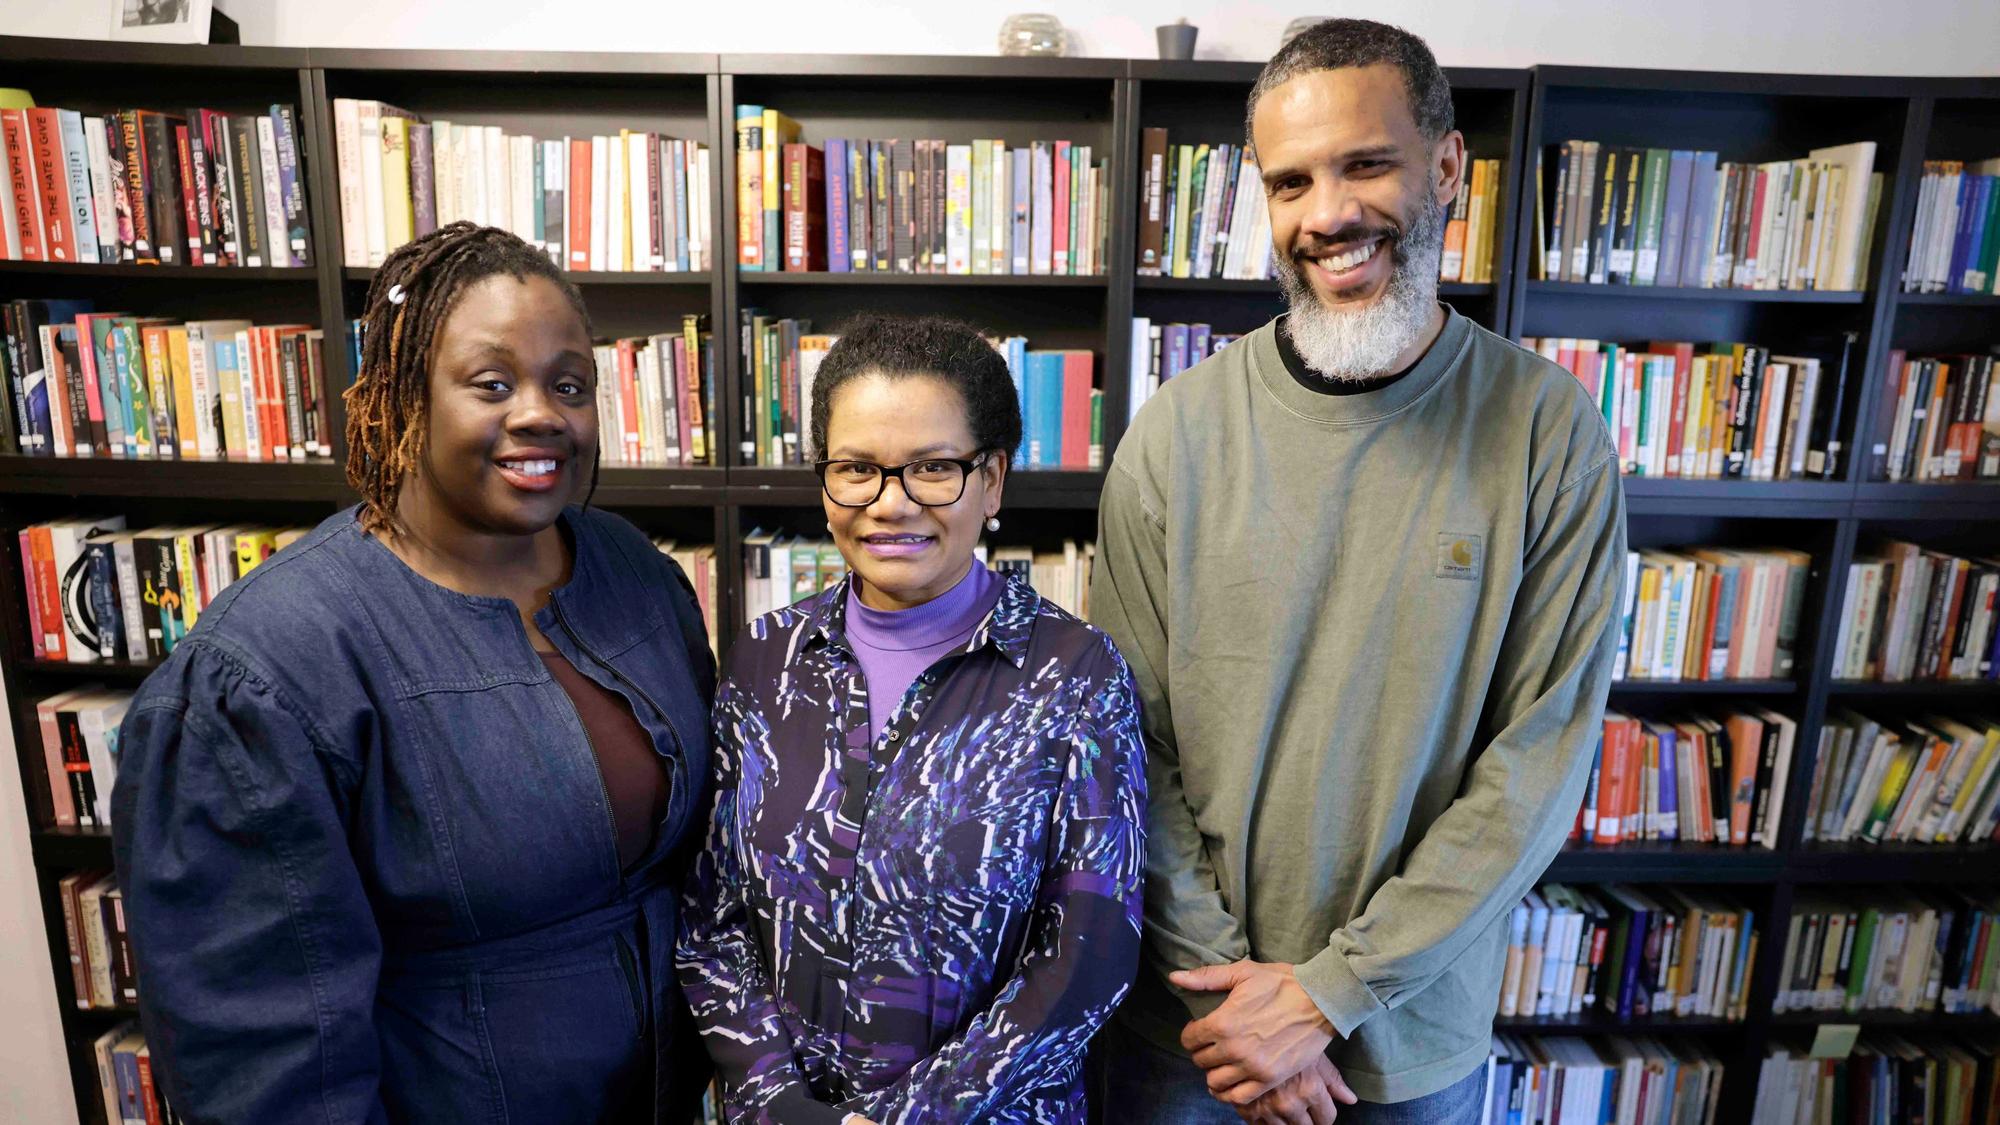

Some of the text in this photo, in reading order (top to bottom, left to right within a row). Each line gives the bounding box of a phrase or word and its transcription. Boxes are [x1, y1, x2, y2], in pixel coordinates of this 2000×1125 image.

[36, 117, 49, 145] GIVE
[42, 149, 51, 157] U
[70, 151, 83, 185] LITTLE
[193, 151, 207, 189] BLACK
[7, 126, 32, 237] THE HATE U GIVE
[42, 161, 55, 191] HATE
[123, 123, 148, 241] BAD WITCH BURNING
[239, 132, 258, 250] WITCHES STEEPED IN GOLD
[47, 195, 58, 217] THE
[76, 196, 89, 226] LION
[199, 191, 210, 226] VEINS
[833, 175, 844, 255] AMERICANAH
[114, 333, 127, 387] LOT
[150, 334, 160, 355] THE
[152, 357, 164, 382] OLD
